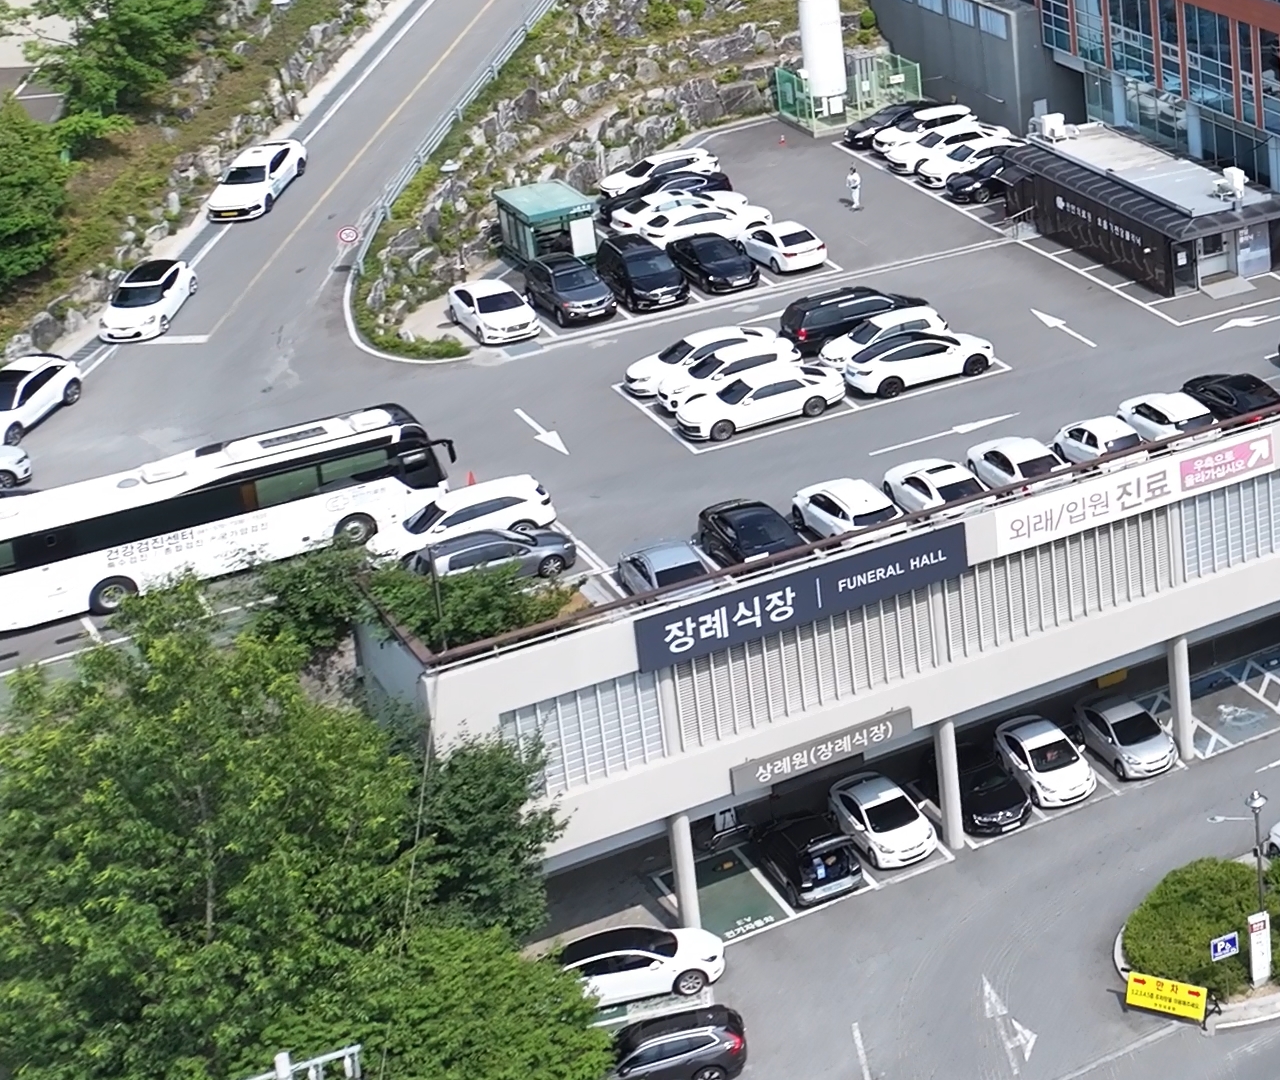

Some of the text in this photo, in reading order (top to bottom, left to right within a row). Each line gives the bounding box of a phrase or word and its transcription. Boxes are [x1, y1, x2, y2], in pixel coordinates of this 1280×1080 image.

[1008, 470, 1172, 540] 외래/입원 진료
[106, 529, 194, 561] 건강검진센터
[837, 549, 947, 593] FUNERAL HALL
[664, 586, 796, 654] 장례식장
[755, 721, 893, 783] 상례원(장례식장)
